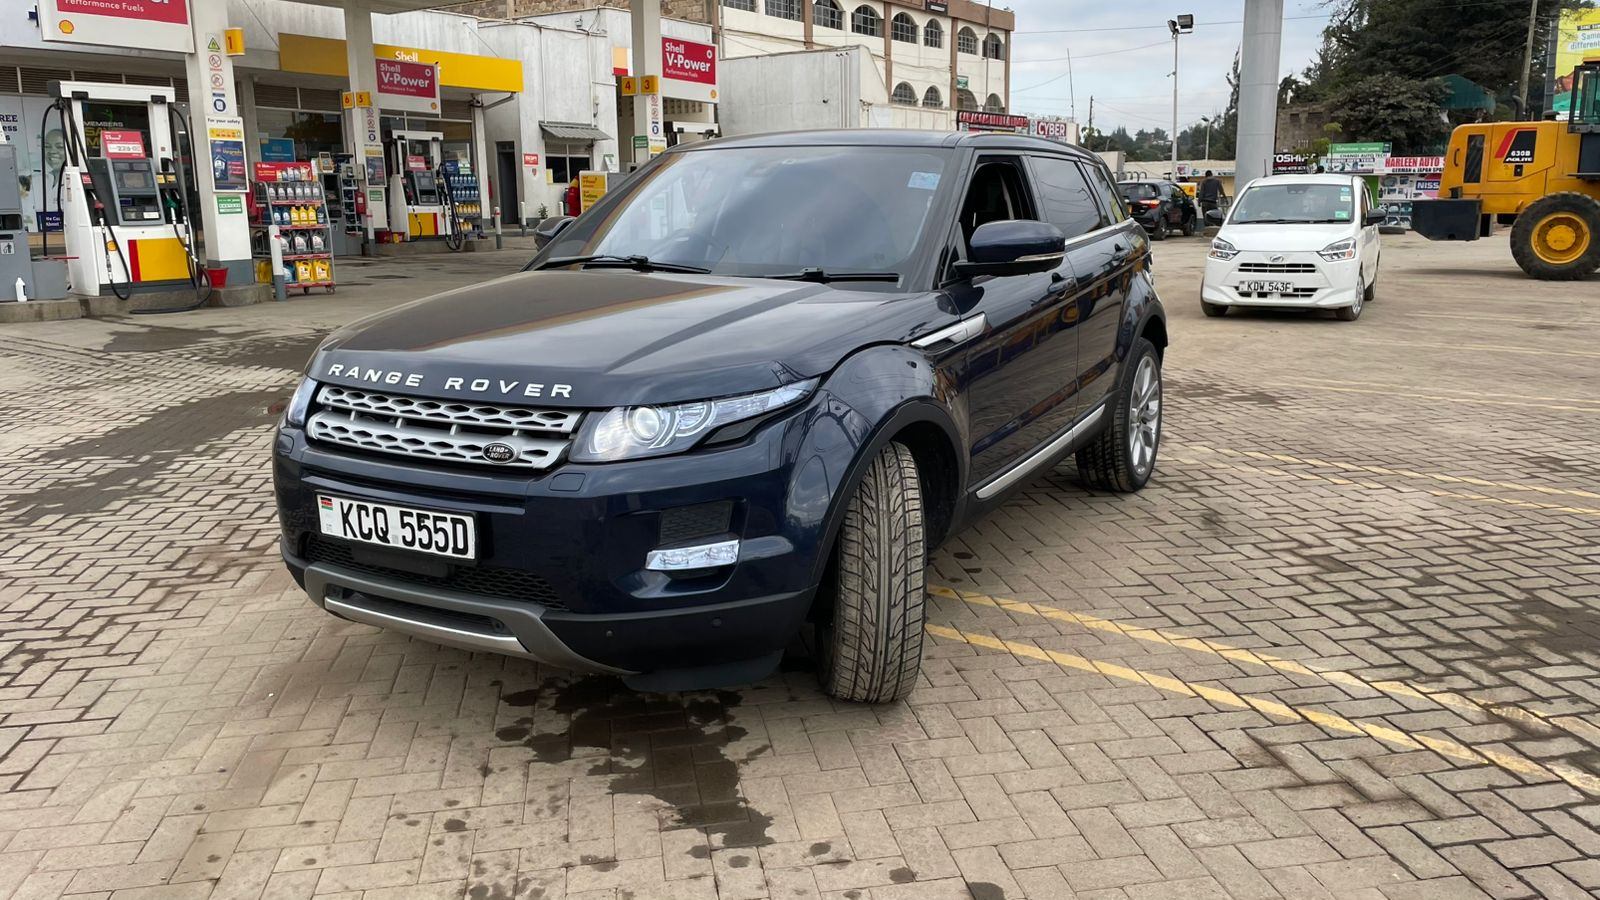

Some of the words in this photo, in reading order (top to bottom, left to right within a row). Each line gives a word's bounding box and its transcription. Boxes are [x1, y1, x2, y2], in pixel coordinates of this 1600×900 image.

[122, 3, 144, 12] Fuels
[228, 36, 234, 49] 1
[665, 42, 685, 54] Shell
[395, 50, 419, 63] Shell
[666, 52, 711, 72] V-Power
[380, 63, 401, 73] Shell
[381, 71, 430, 88] V-Power
[644, 79, 650, 90] 3
[624, 80, 632, 91] 4
[344, 95, 350, 104] 6
[359, 94, 364, 103] 5
[1038, 122, 1066, 136] CYBER
[1385, 157, 1417, 168] HARLEEN
[1419, 157, 1440, 167] AUTO
[1416, 181, 1440, 189] NISS
[1247, 281, 1265, 292] KDW
[1268, 281, 1291, 292] 543F
[328, 363, 424, 387] RANGE
[444, 377, 573, 398] ROVER
[340, 501, 391, 544] KCQ
[400, 510, 469, 555] 555D
